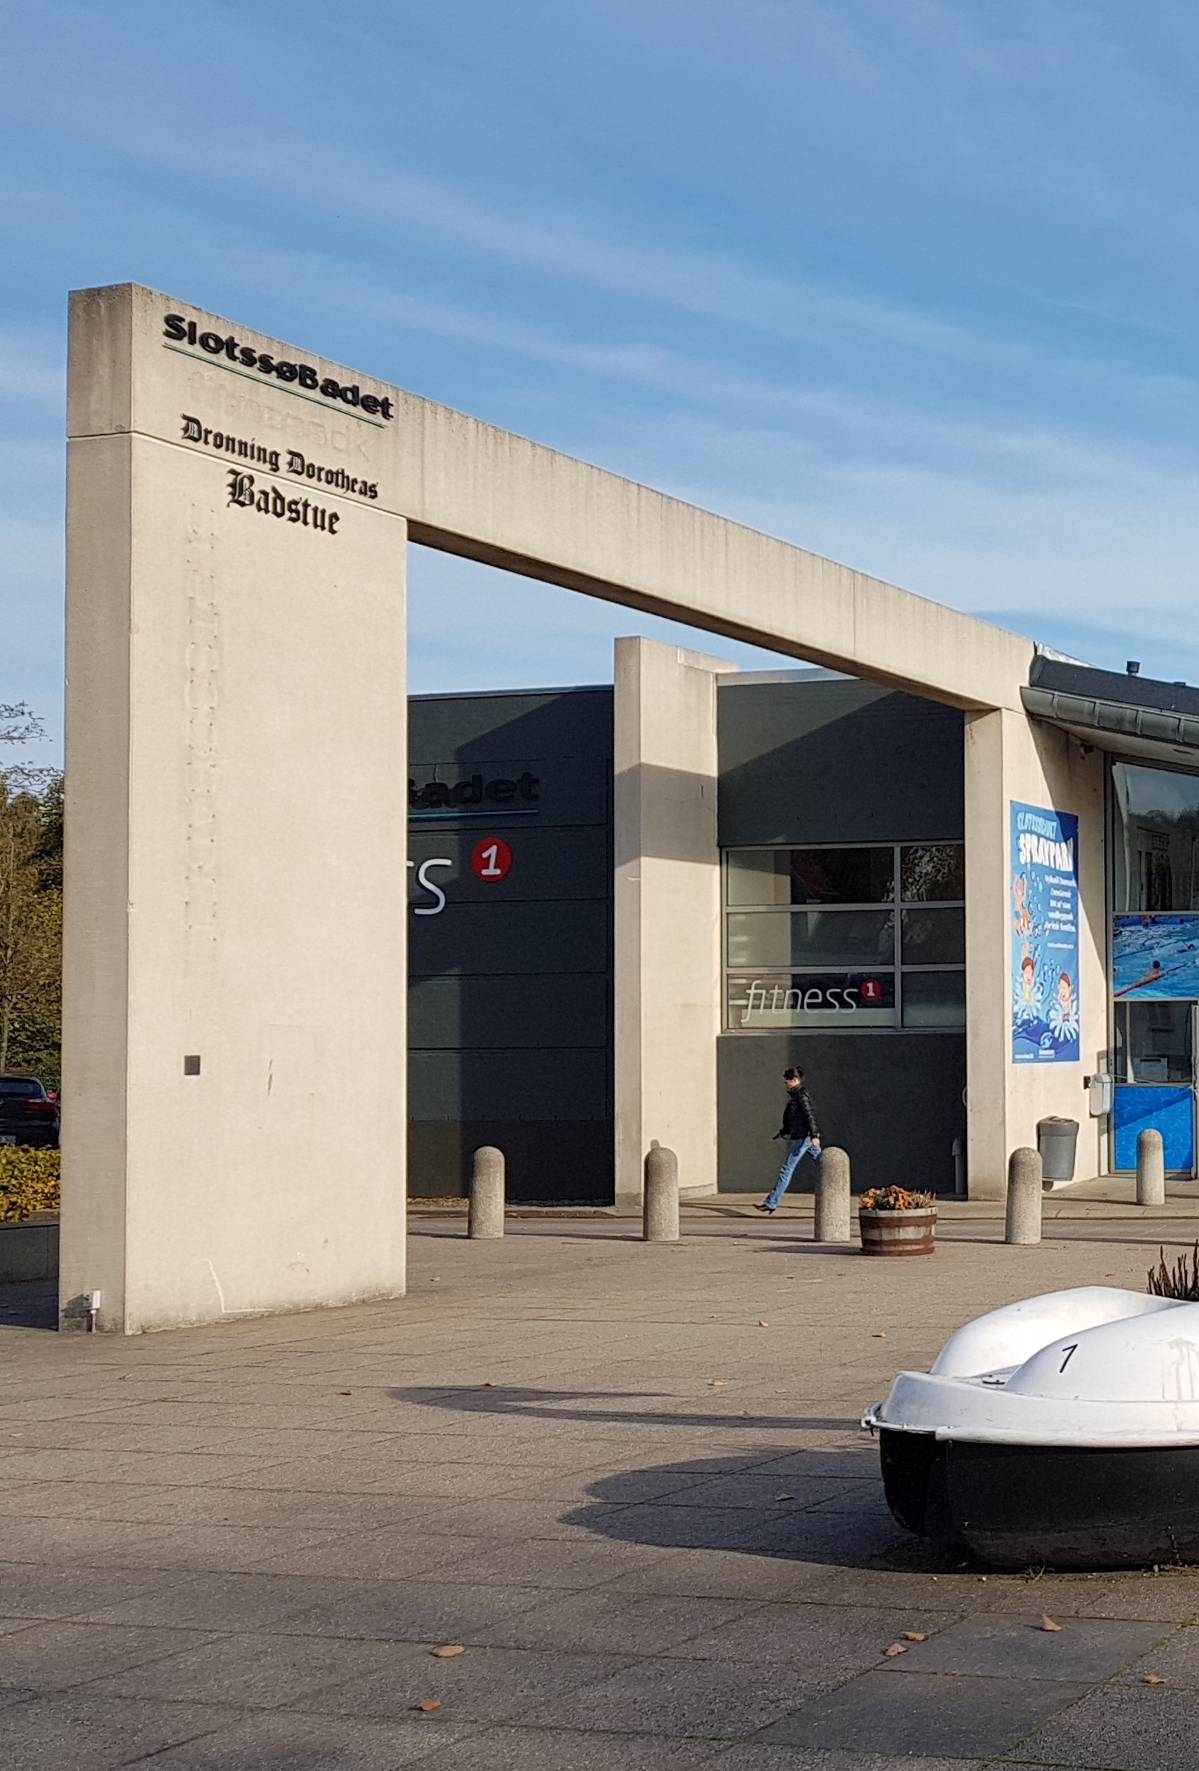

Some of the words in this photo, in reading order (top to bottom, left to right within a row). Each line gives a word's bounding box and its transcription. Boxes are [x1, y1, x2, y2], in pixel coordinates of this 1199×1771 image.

[162, 313, 395, 421] SlotssøBadet
[180, 413, 281, 473] Dronning
[286, 449, 379, 500] Dorotheas
[226, 468, 341, 535] Badstue
[741, 980, 859, 1023] fitness
